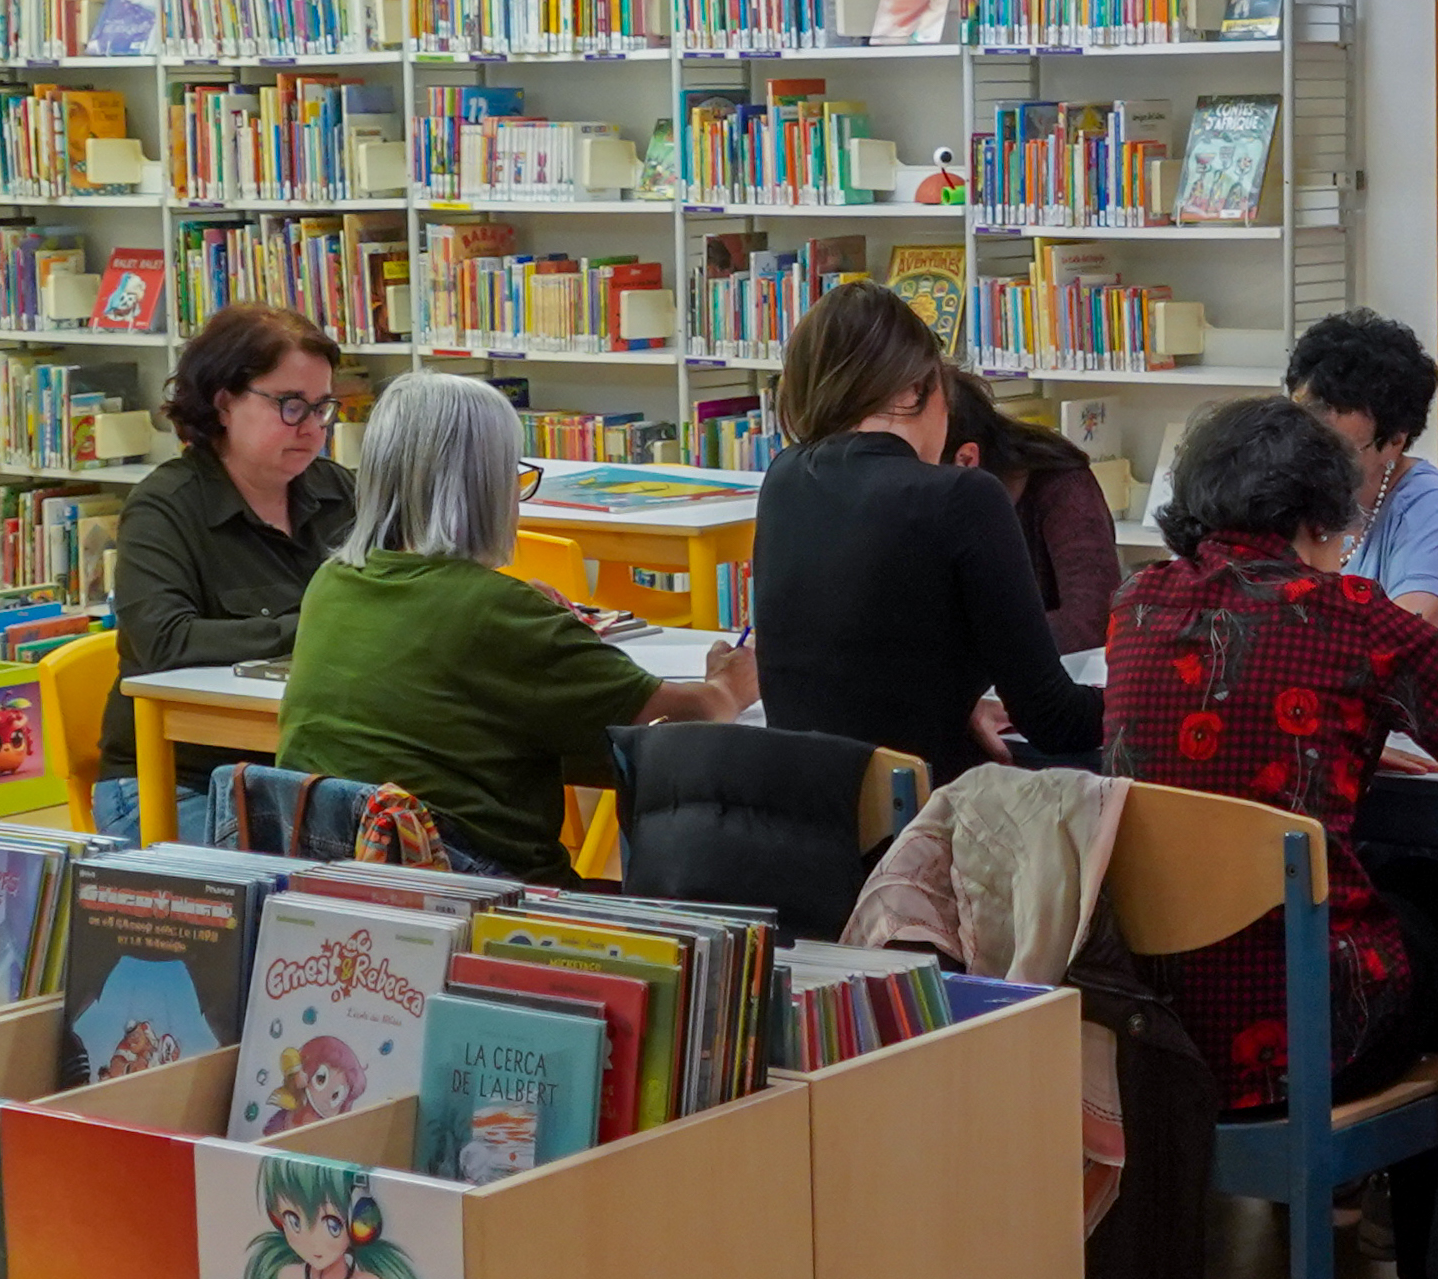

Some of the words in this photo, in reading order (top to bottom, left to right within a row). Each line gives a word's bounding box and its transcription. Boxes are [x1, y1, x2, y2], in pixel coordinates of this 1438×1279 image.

[1216, 103, 1257, 117] CONTES
[266, 941, 342, 1000] Ernest
[352, 953, 426, 1018] Rebecca
[465, 1042, 486, 1068] LA
[493, 1046, 548, 1078] CERCA
[451, 1069, 471, 1093] DE
[480, 1074, 559, 1106] L'ALBERT
